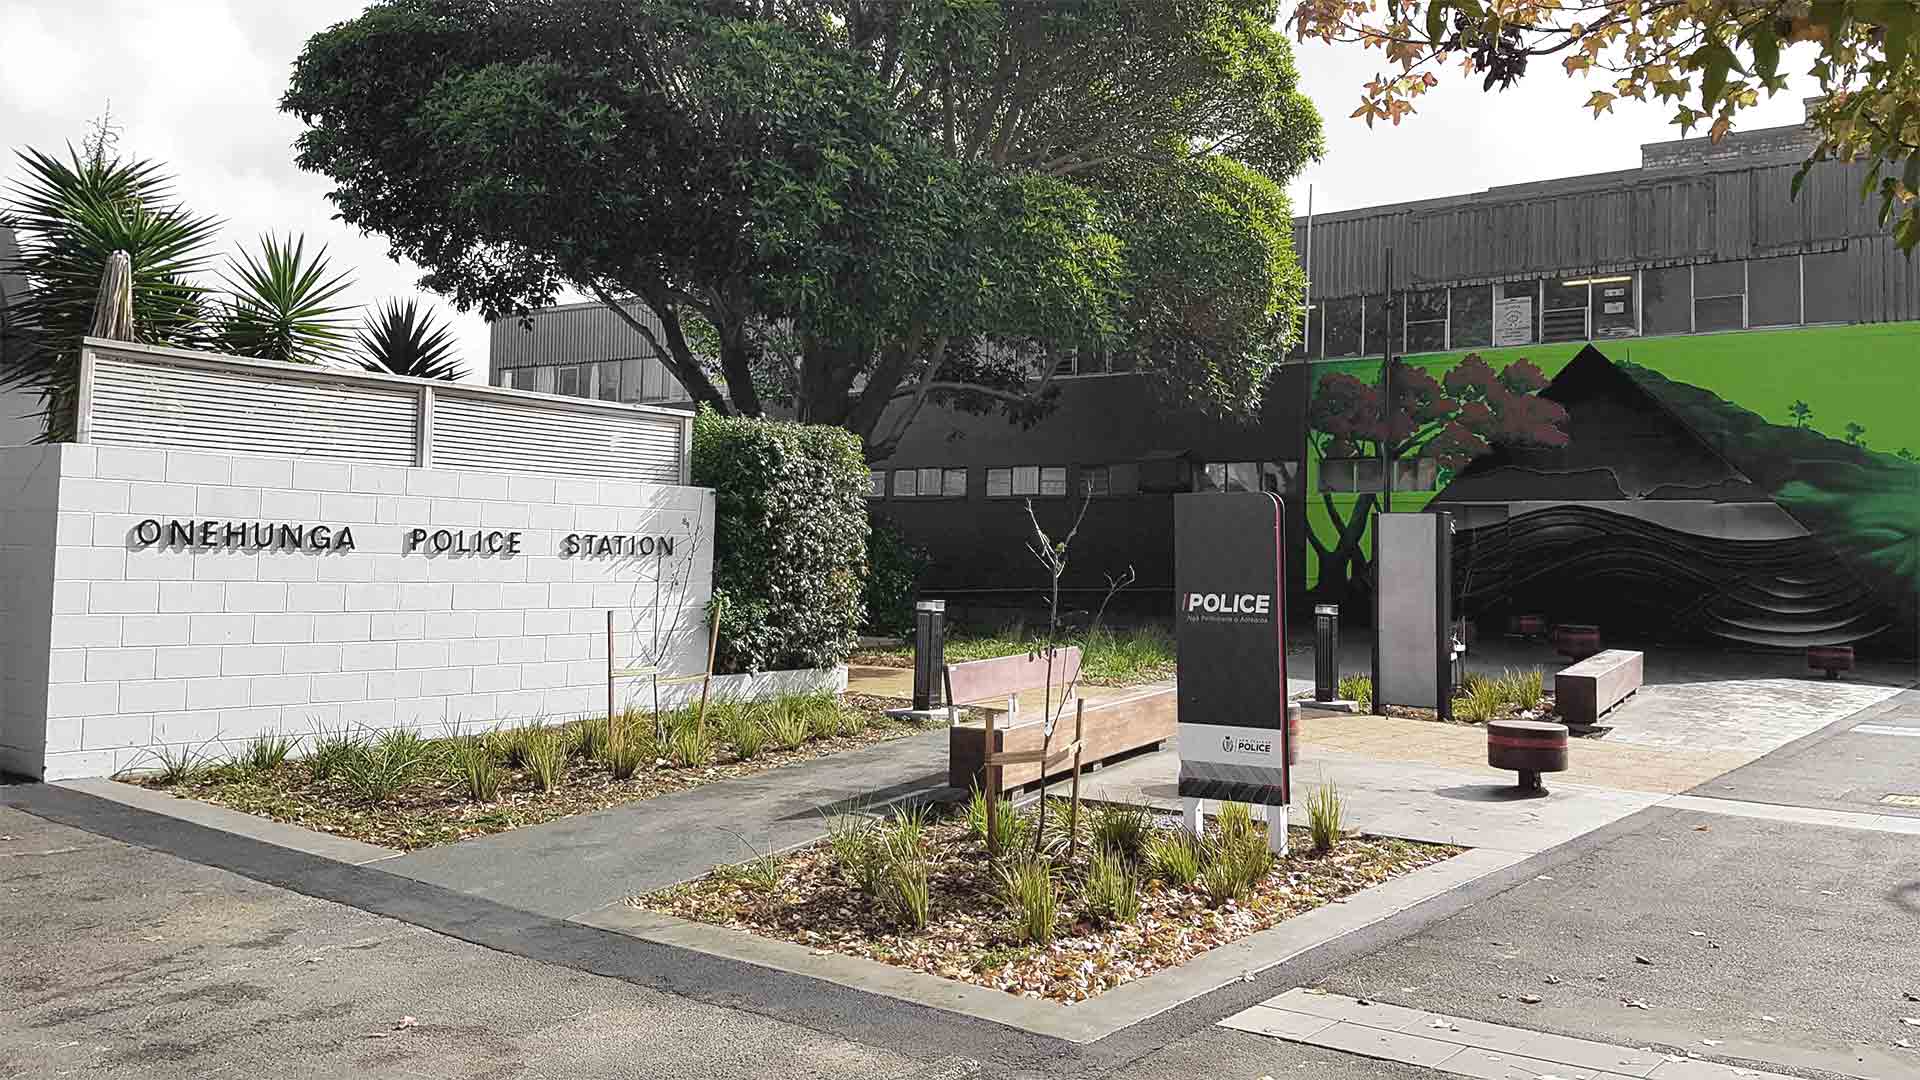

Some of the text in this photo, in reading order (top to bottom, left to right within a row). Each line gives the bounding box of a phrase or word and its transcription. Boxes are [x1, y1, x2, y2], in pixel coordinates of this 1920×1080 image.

[136, 518, 676, 556] ONEHUNGA POLICE STATION
[1188, 593, 1270, 614] POLICE
[1239, 743, 1271, 753] POLICE
